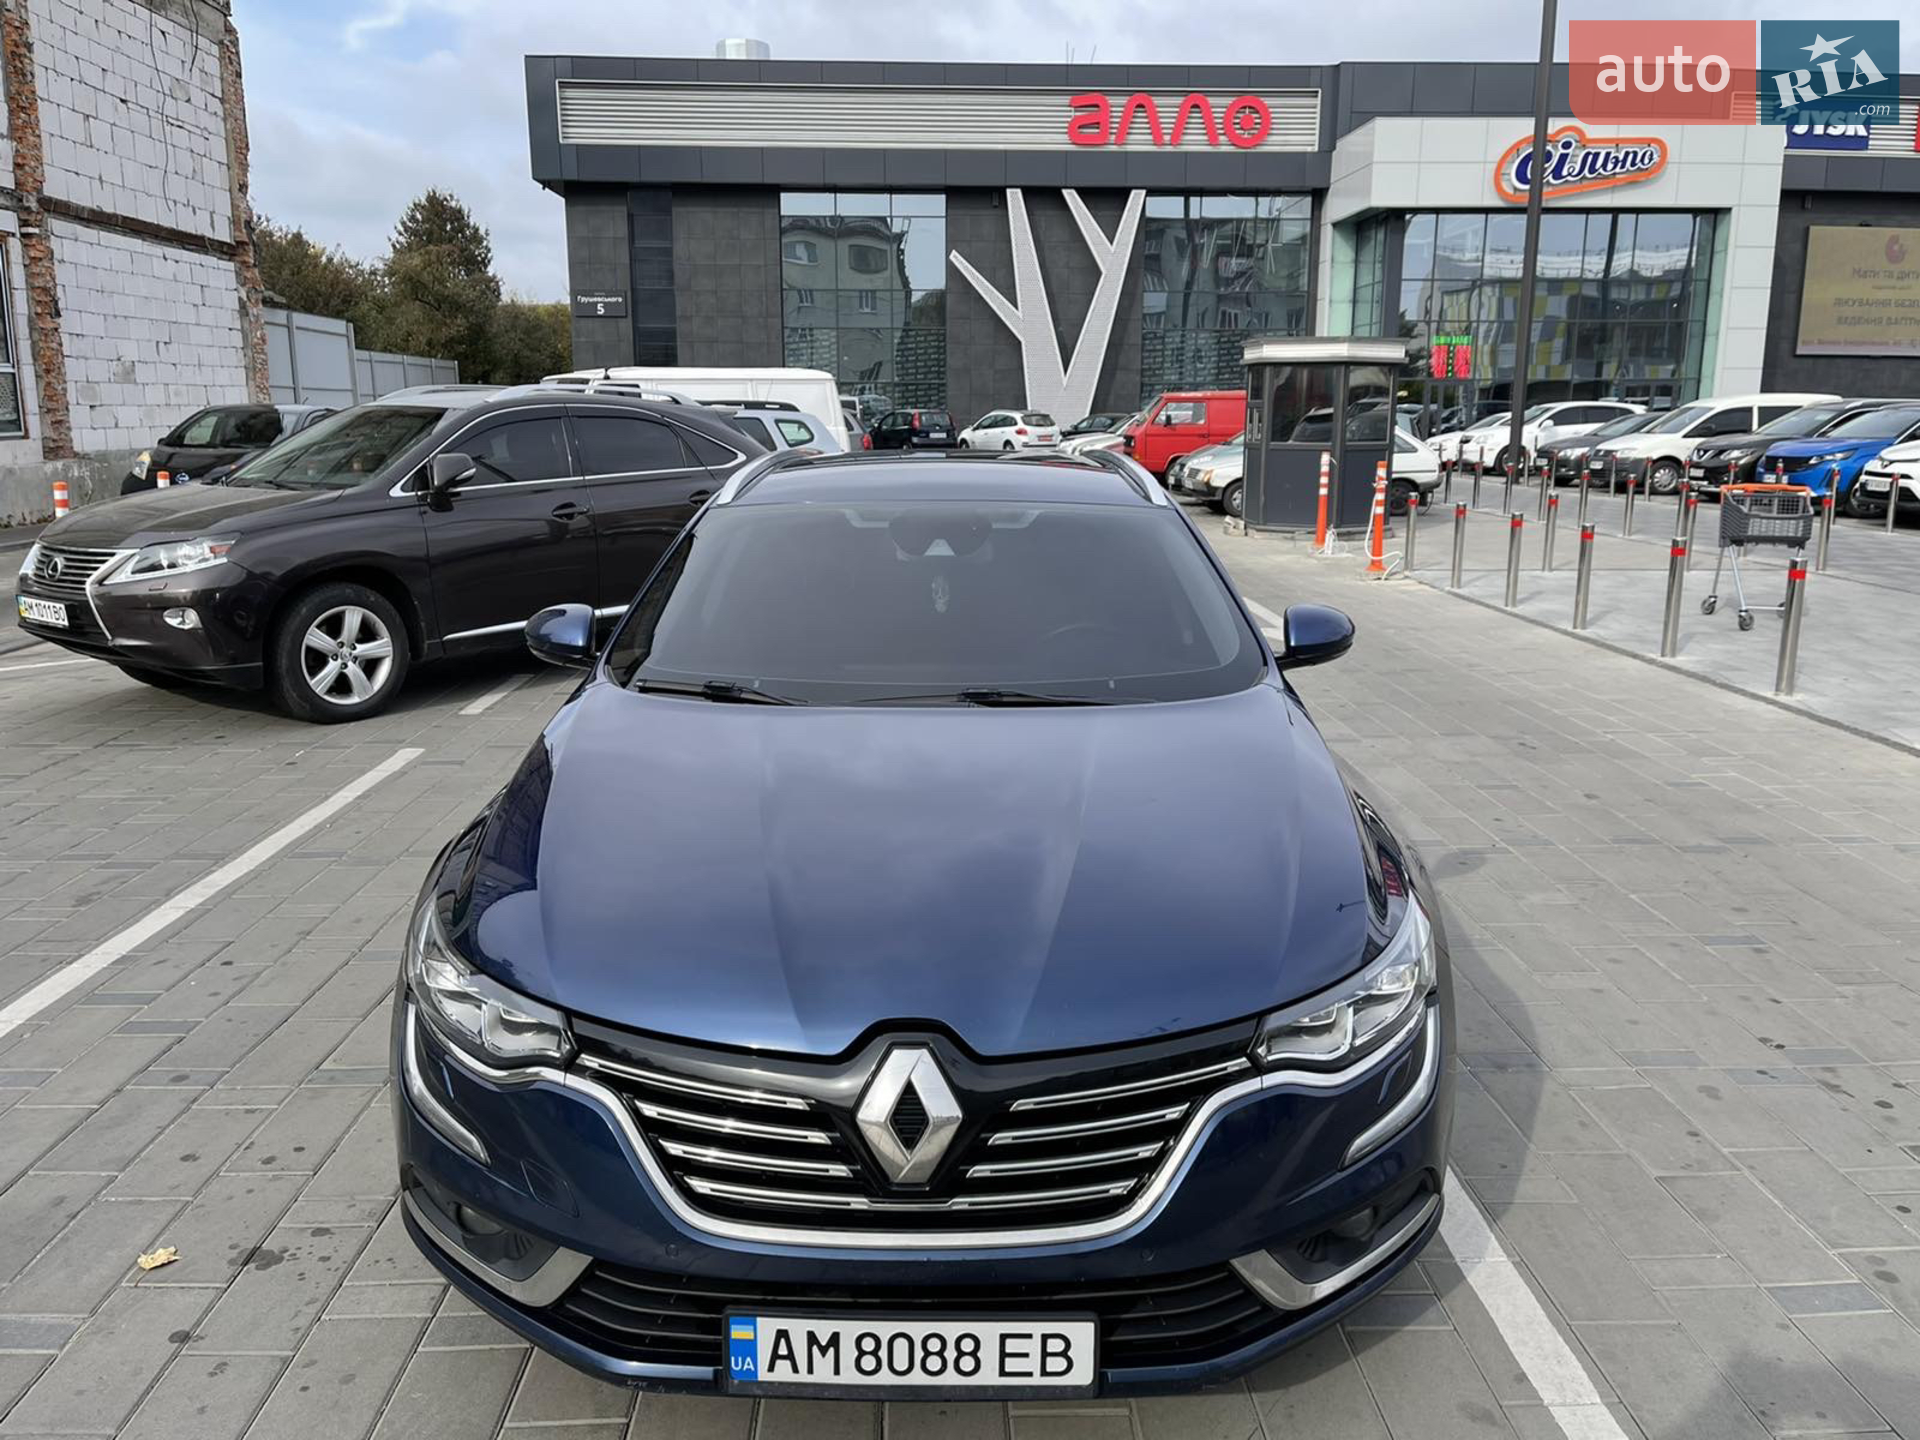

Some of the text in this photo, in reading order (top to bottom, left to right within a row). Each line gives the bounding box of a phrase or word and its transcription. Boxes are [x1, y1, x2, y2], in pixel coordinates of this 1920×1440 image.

[1792, 109, 1869, 137] JYSK
[596, 303, 605, 315] 5
[731, 1356, 755, 1372] UA
[767, 1328, 1074, 1378] AM 8088 EB
